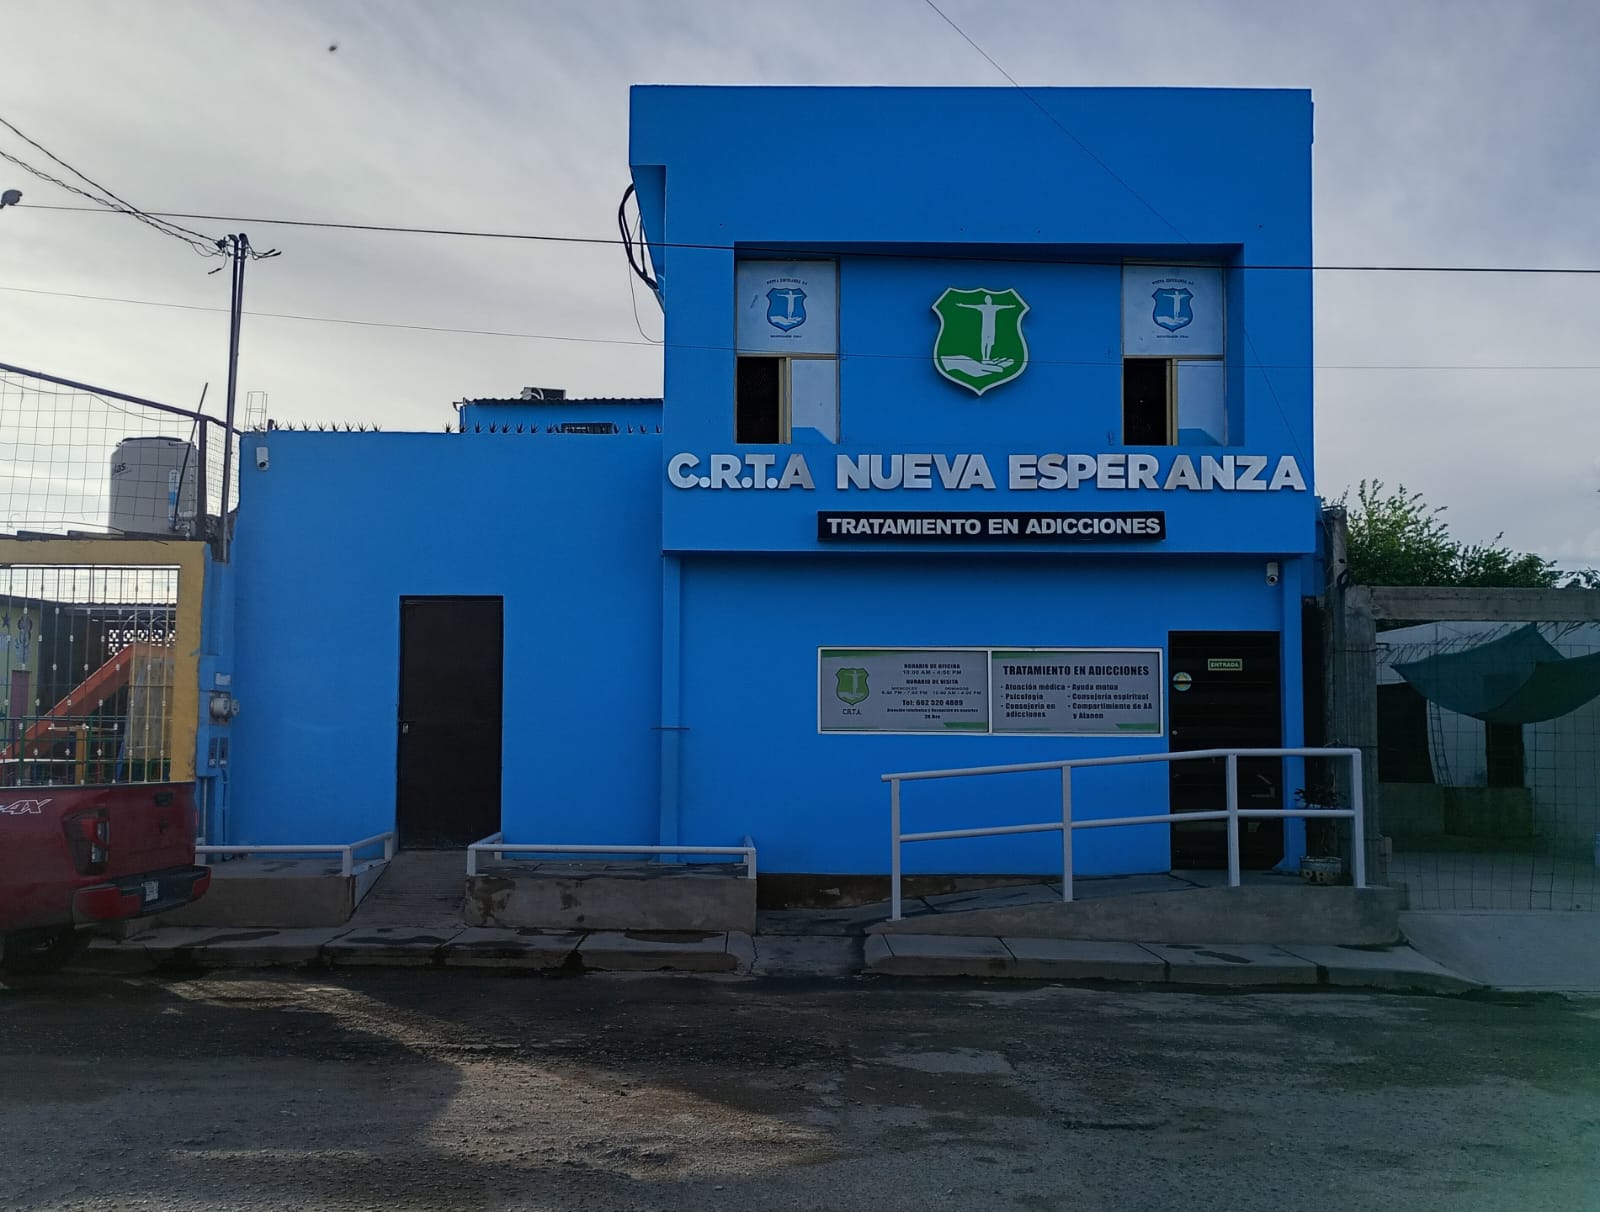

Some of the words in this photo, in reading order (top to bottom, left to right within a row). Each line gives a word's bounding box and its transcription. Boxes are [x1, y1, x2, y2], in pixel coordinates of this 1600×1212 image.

[668, 453, 815, 489] C.R.T.A
[837, 454, 996, 490] NUEVA
[1009, 454, 1307, 491] ESPERANZA
[827, 518, 982, 535] TRATAMIENTO
[988, 518, 1019, 535] EN
[1025, 518, 1161, 535] ADICCIONES
[1003, 665, 1071, 676] TRATAMIENTO
[1073, 665, 1086, 676] EN
[1088, 665, 1150, 676] ADICCIONES
[1072, 683, 1094, 691] Ayuda
